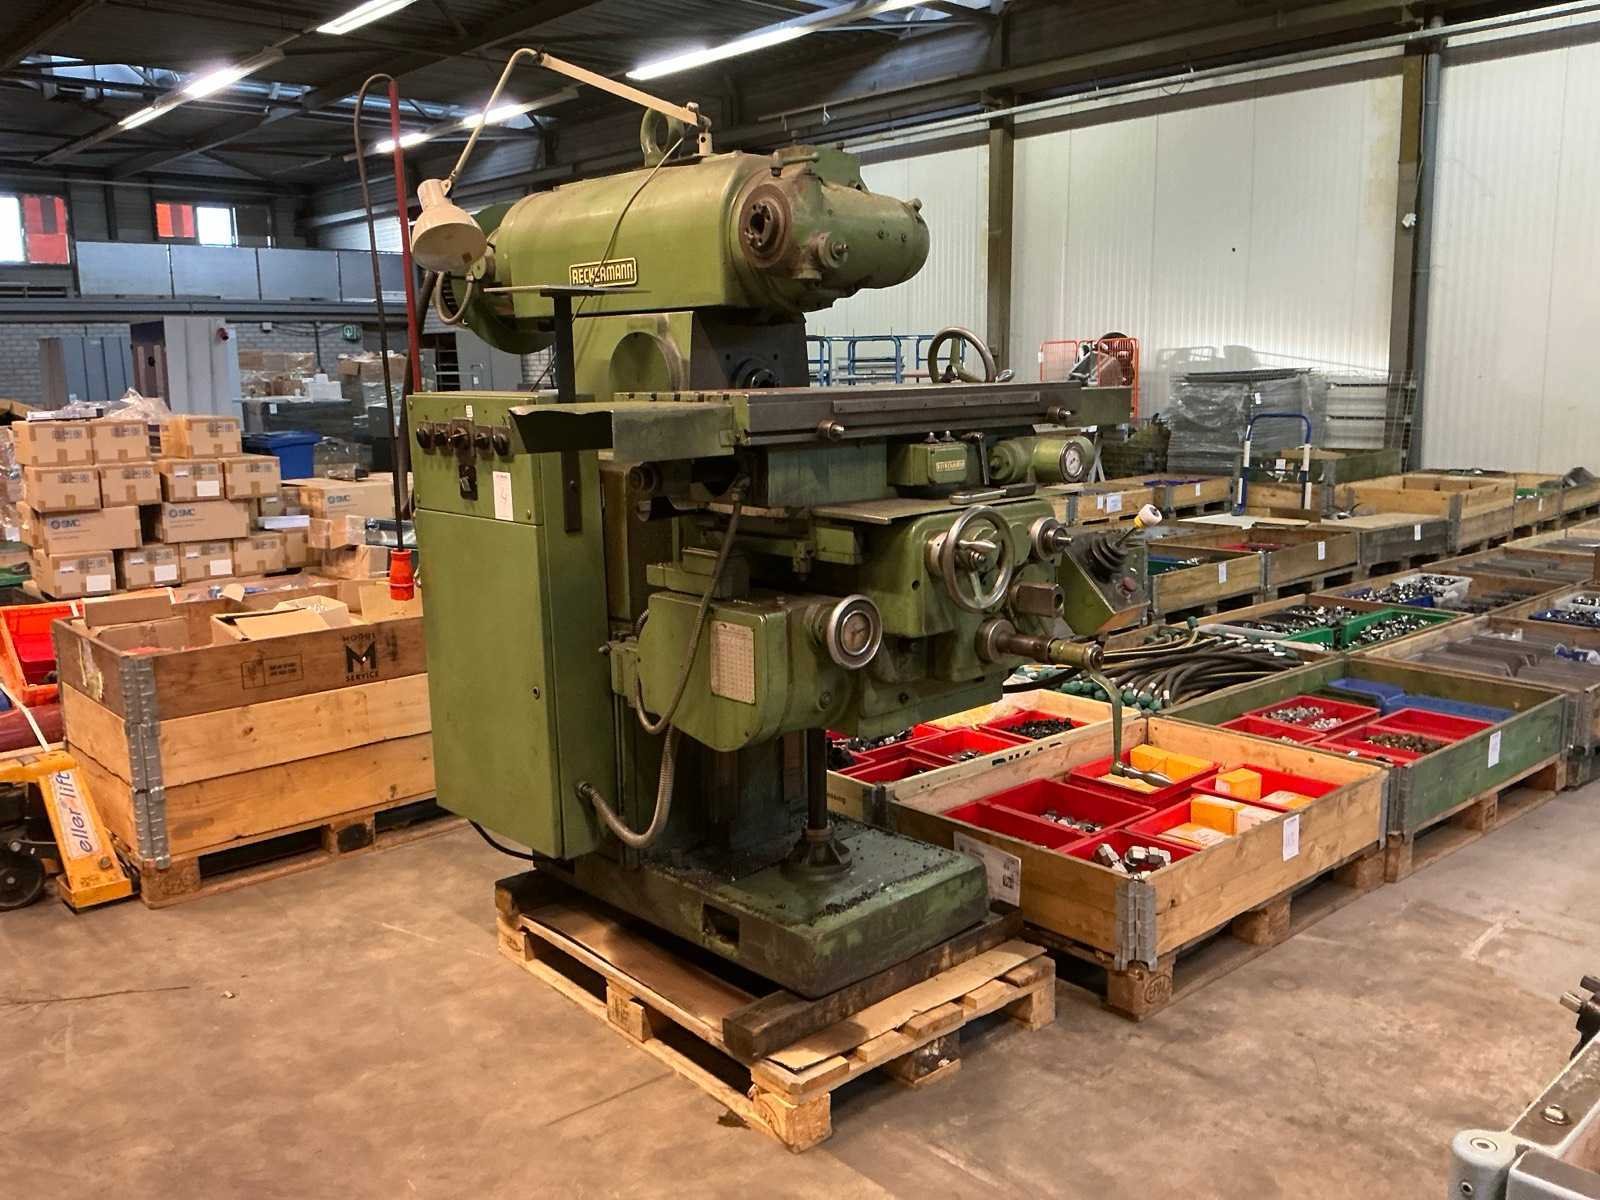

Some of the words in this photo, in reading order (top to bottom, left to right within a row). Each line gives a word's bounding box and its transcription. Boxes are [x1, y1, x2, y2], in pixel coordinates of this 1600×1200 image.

[345, 641, 377, 673] M
[345, 671, 379, 682] SERVICE
[71, 807, 93, 852] eller
